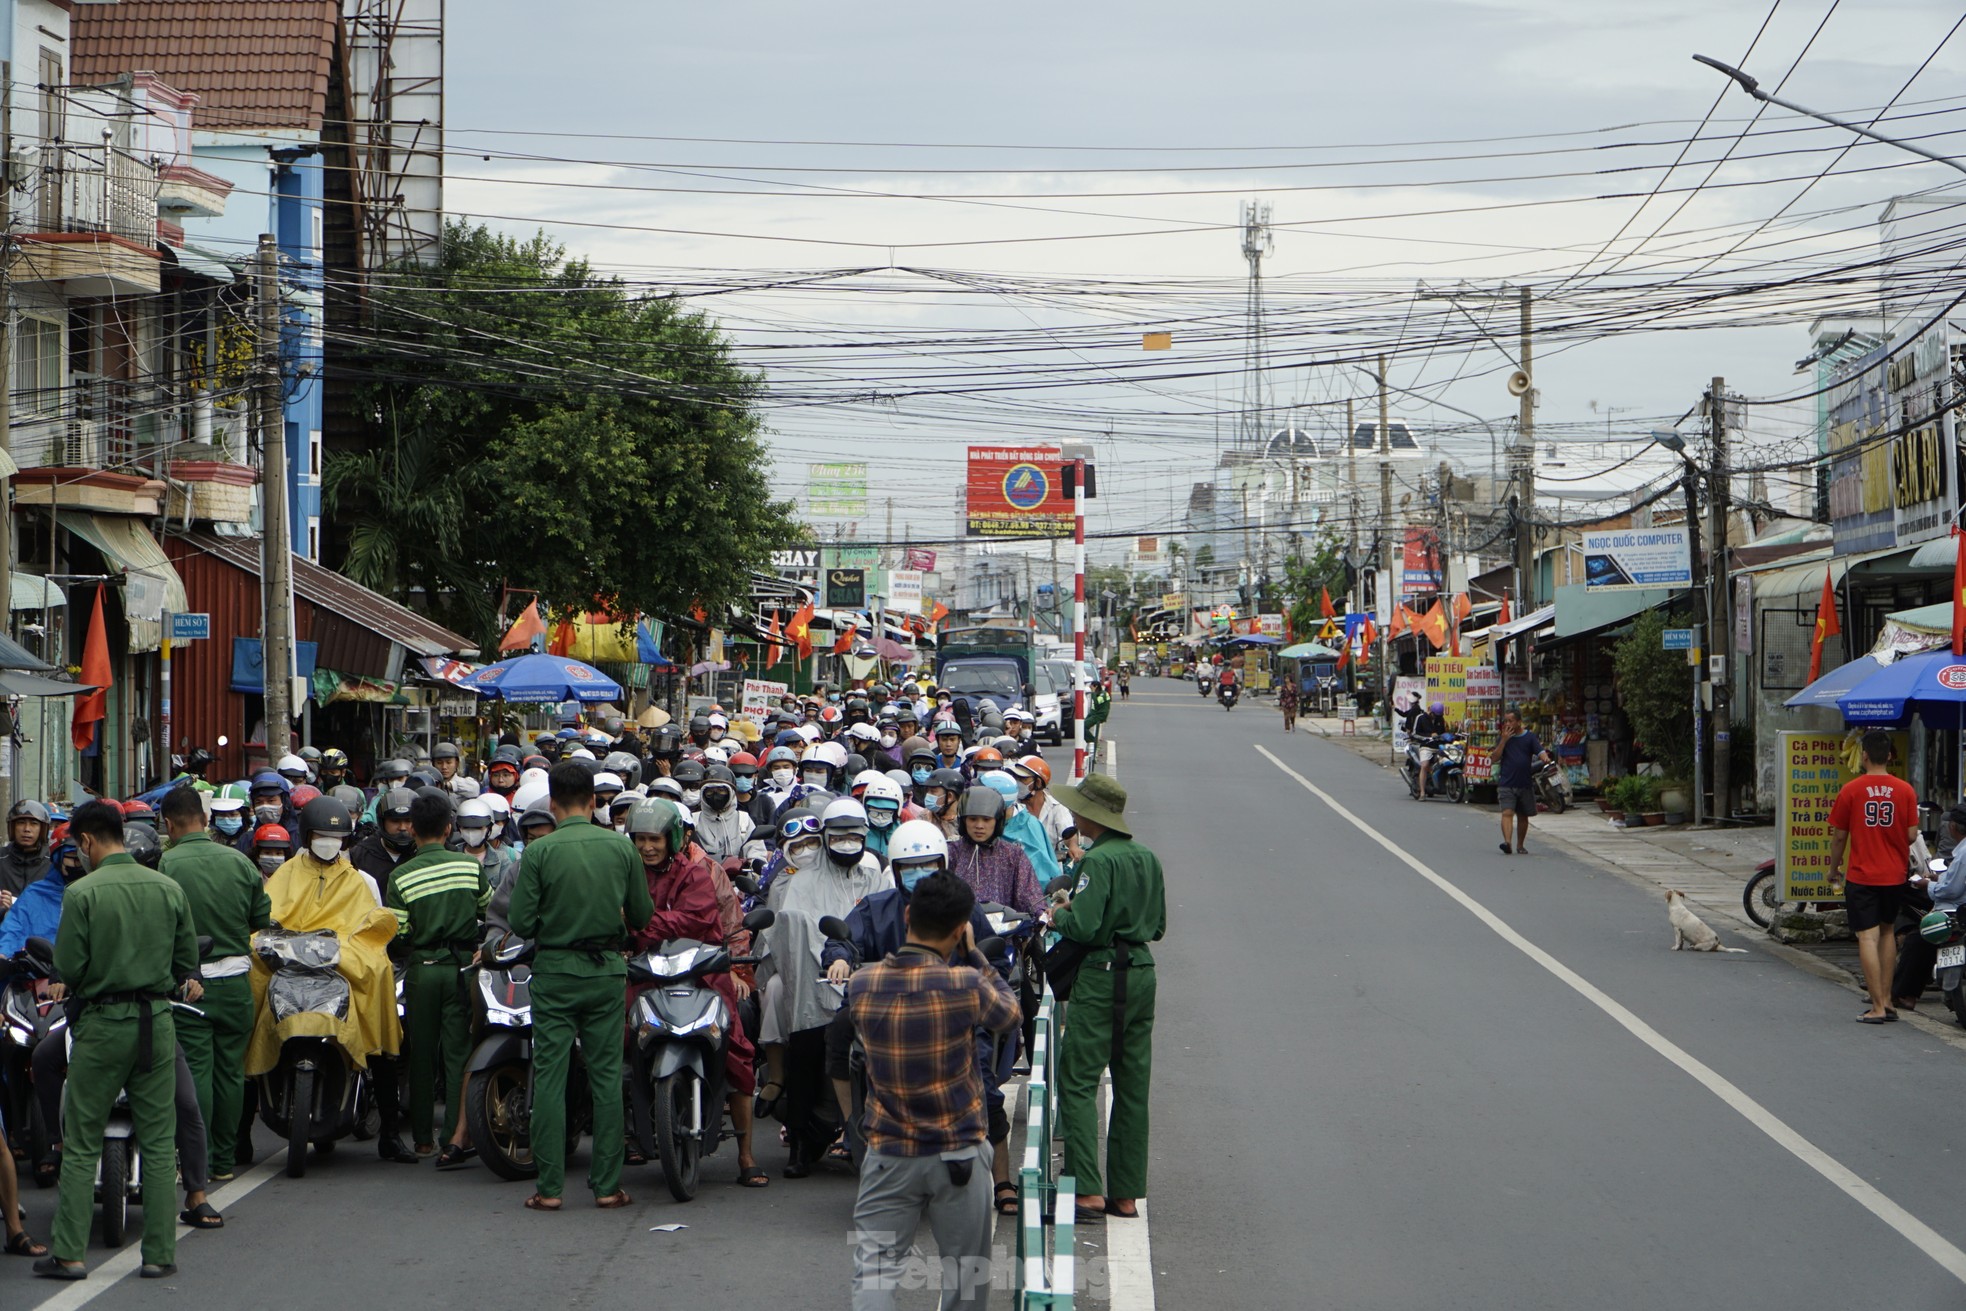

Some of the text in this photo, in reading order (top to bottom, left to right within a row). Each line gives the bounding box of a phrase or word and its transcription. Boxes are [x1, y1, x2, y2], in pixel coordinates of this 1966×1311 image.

[1588, 533, 1683, 550] NGỌC QUỐC COMPUTER
[1428, 660, 1464, 674] HỦ TIẾU
[1449, 678, 1465, 688] NUI
[762, 685, 784, 694] Thanh
[1812, 739, 1834, 751] Phê
[1812, 754, 1835, 766] Phê
[1792, 768, 1839, 780] Rau Má
[1792, 784, 1820, 794] Cam
[1792, 797, 1811, 808] Trà
[1792, 812, 1830, 822] Trà Đà
[1864, 801, 1894, 828] 93
[1792, 825, 1824, 836] Nước
[1792, 840, 1819, 850] Sinh
[1792, 856, 1808, 866] Trà
[1810, 856, 1822, 866] Bí
[1792, 870, 1824, 881] Chanh
[1791, 884, 1814, 896] Nước
